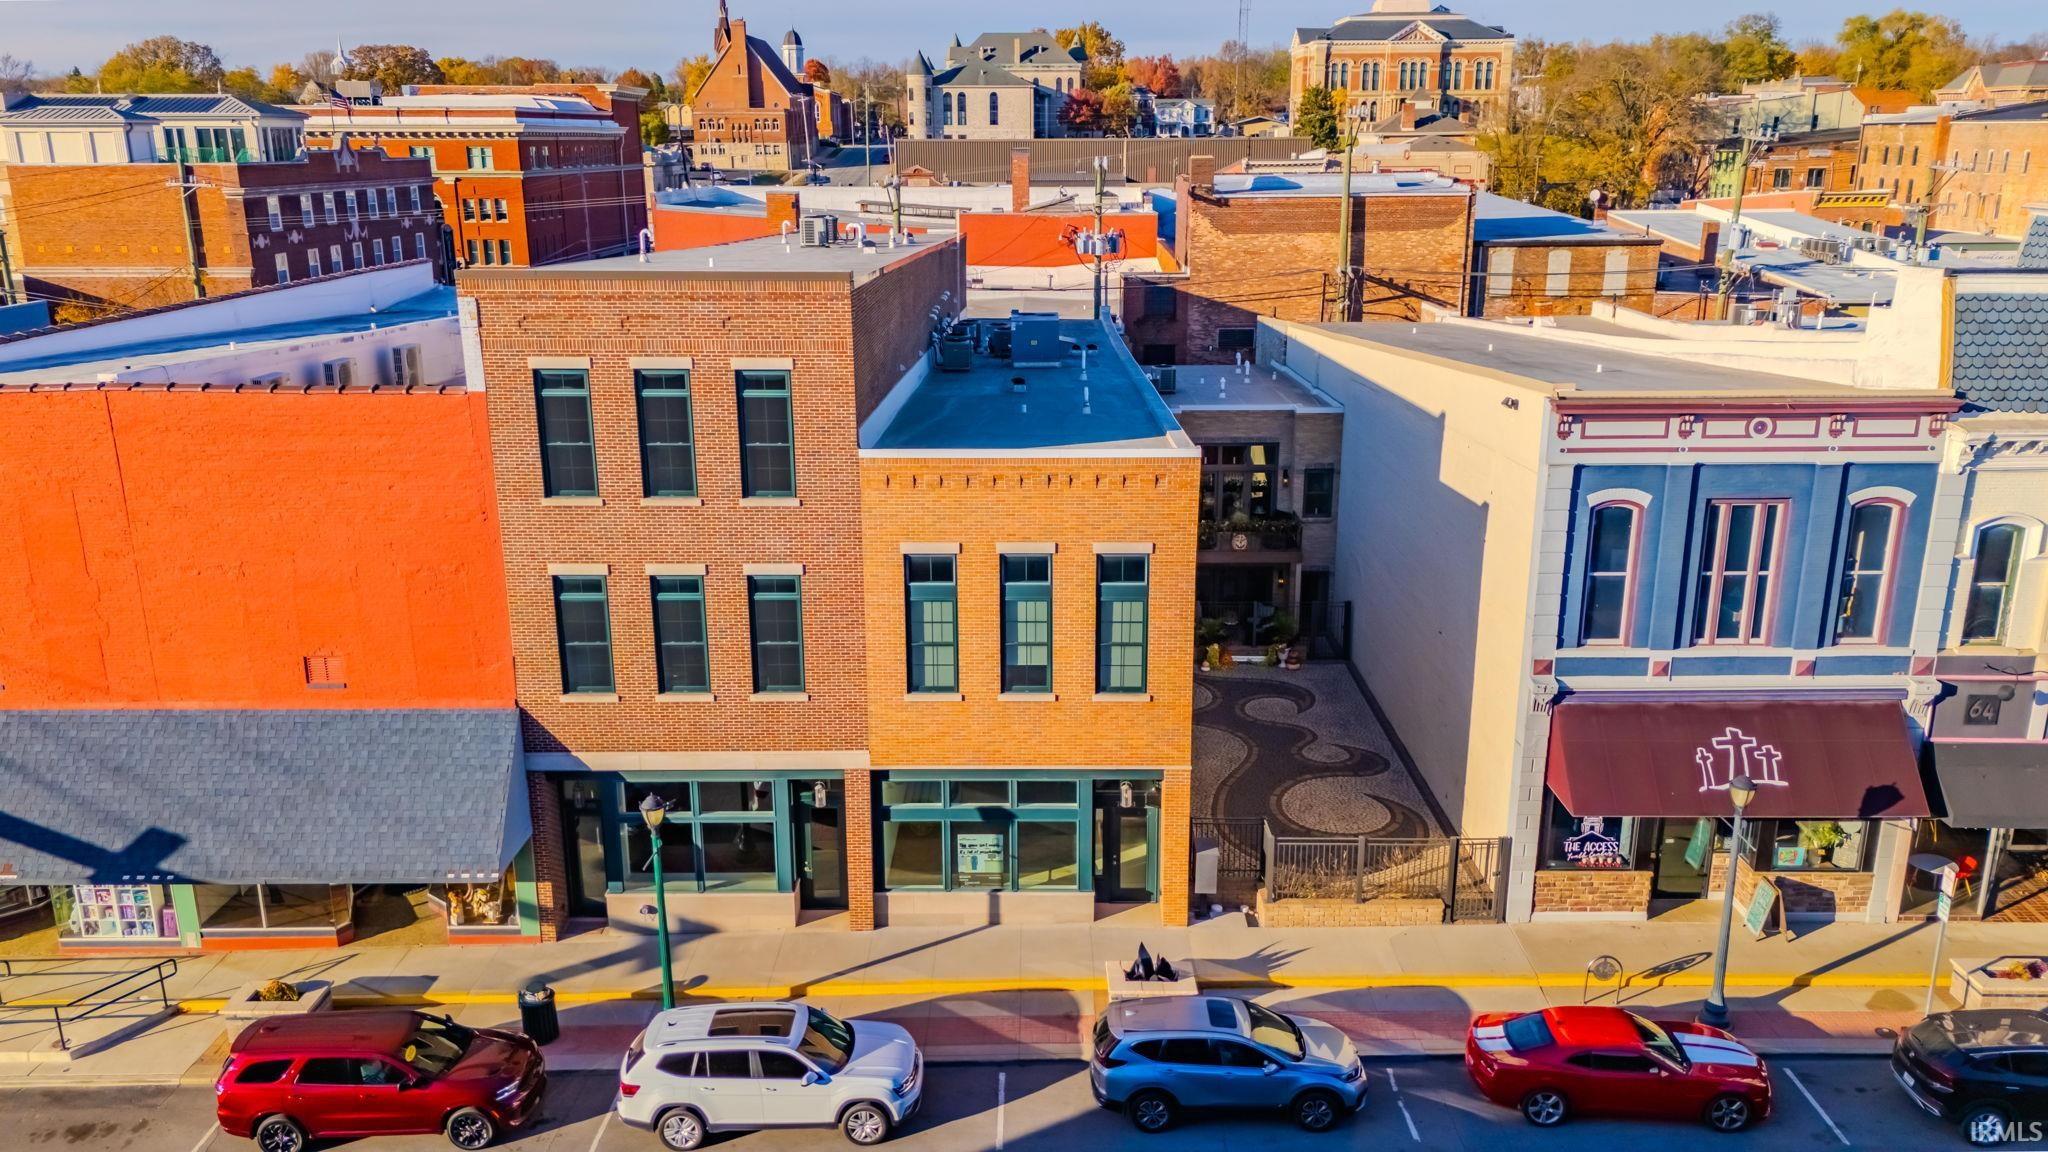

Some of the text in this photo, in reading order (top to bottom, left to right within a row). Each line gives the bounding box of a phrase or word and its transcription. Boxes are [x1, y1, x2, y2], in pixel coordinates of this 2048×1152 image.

[1969, 699, 1994, 720] 64
[1563, 841, 1619, 852] THE ACCESS
